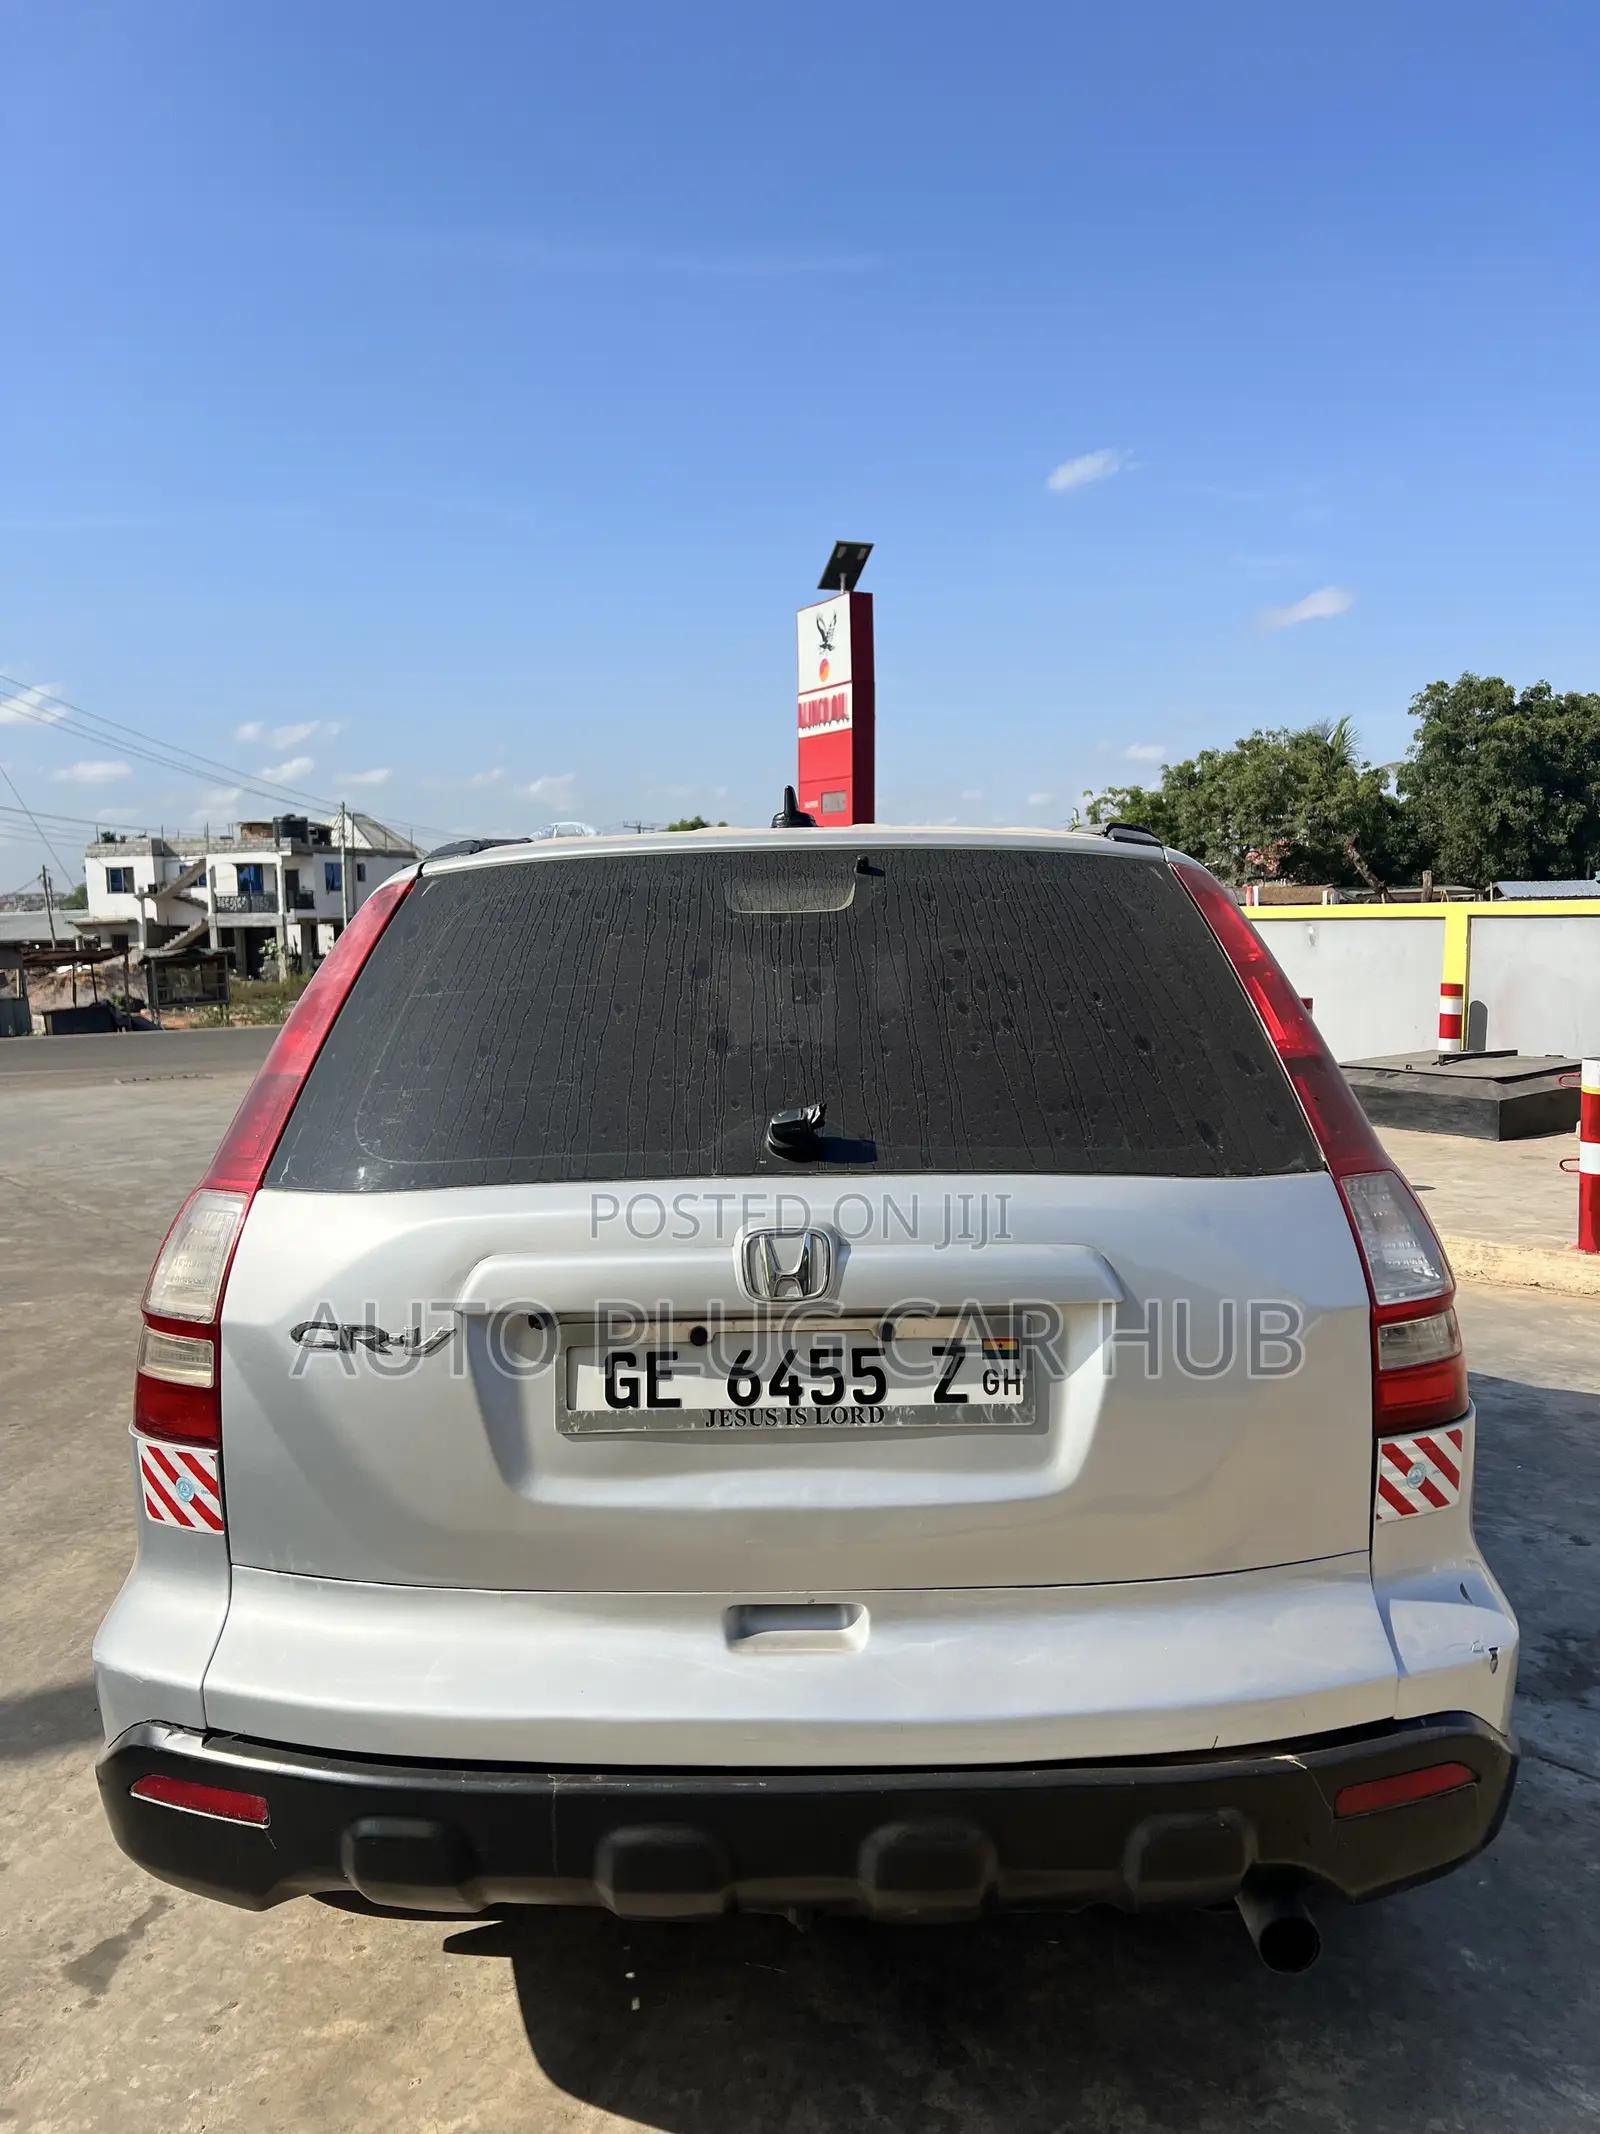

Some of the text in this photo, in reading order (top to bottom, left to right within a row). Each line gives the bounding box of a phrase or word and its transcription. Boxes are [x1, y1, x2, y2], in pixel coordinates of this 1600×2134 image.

[289, 1320, 456, 1357] CR-V
[603, 1346, 970, 1409] GE 6455 Z
[981, 1368, 1024, 1396] GH
[705, 1406, 885, 1428] JESUS IS LORD
